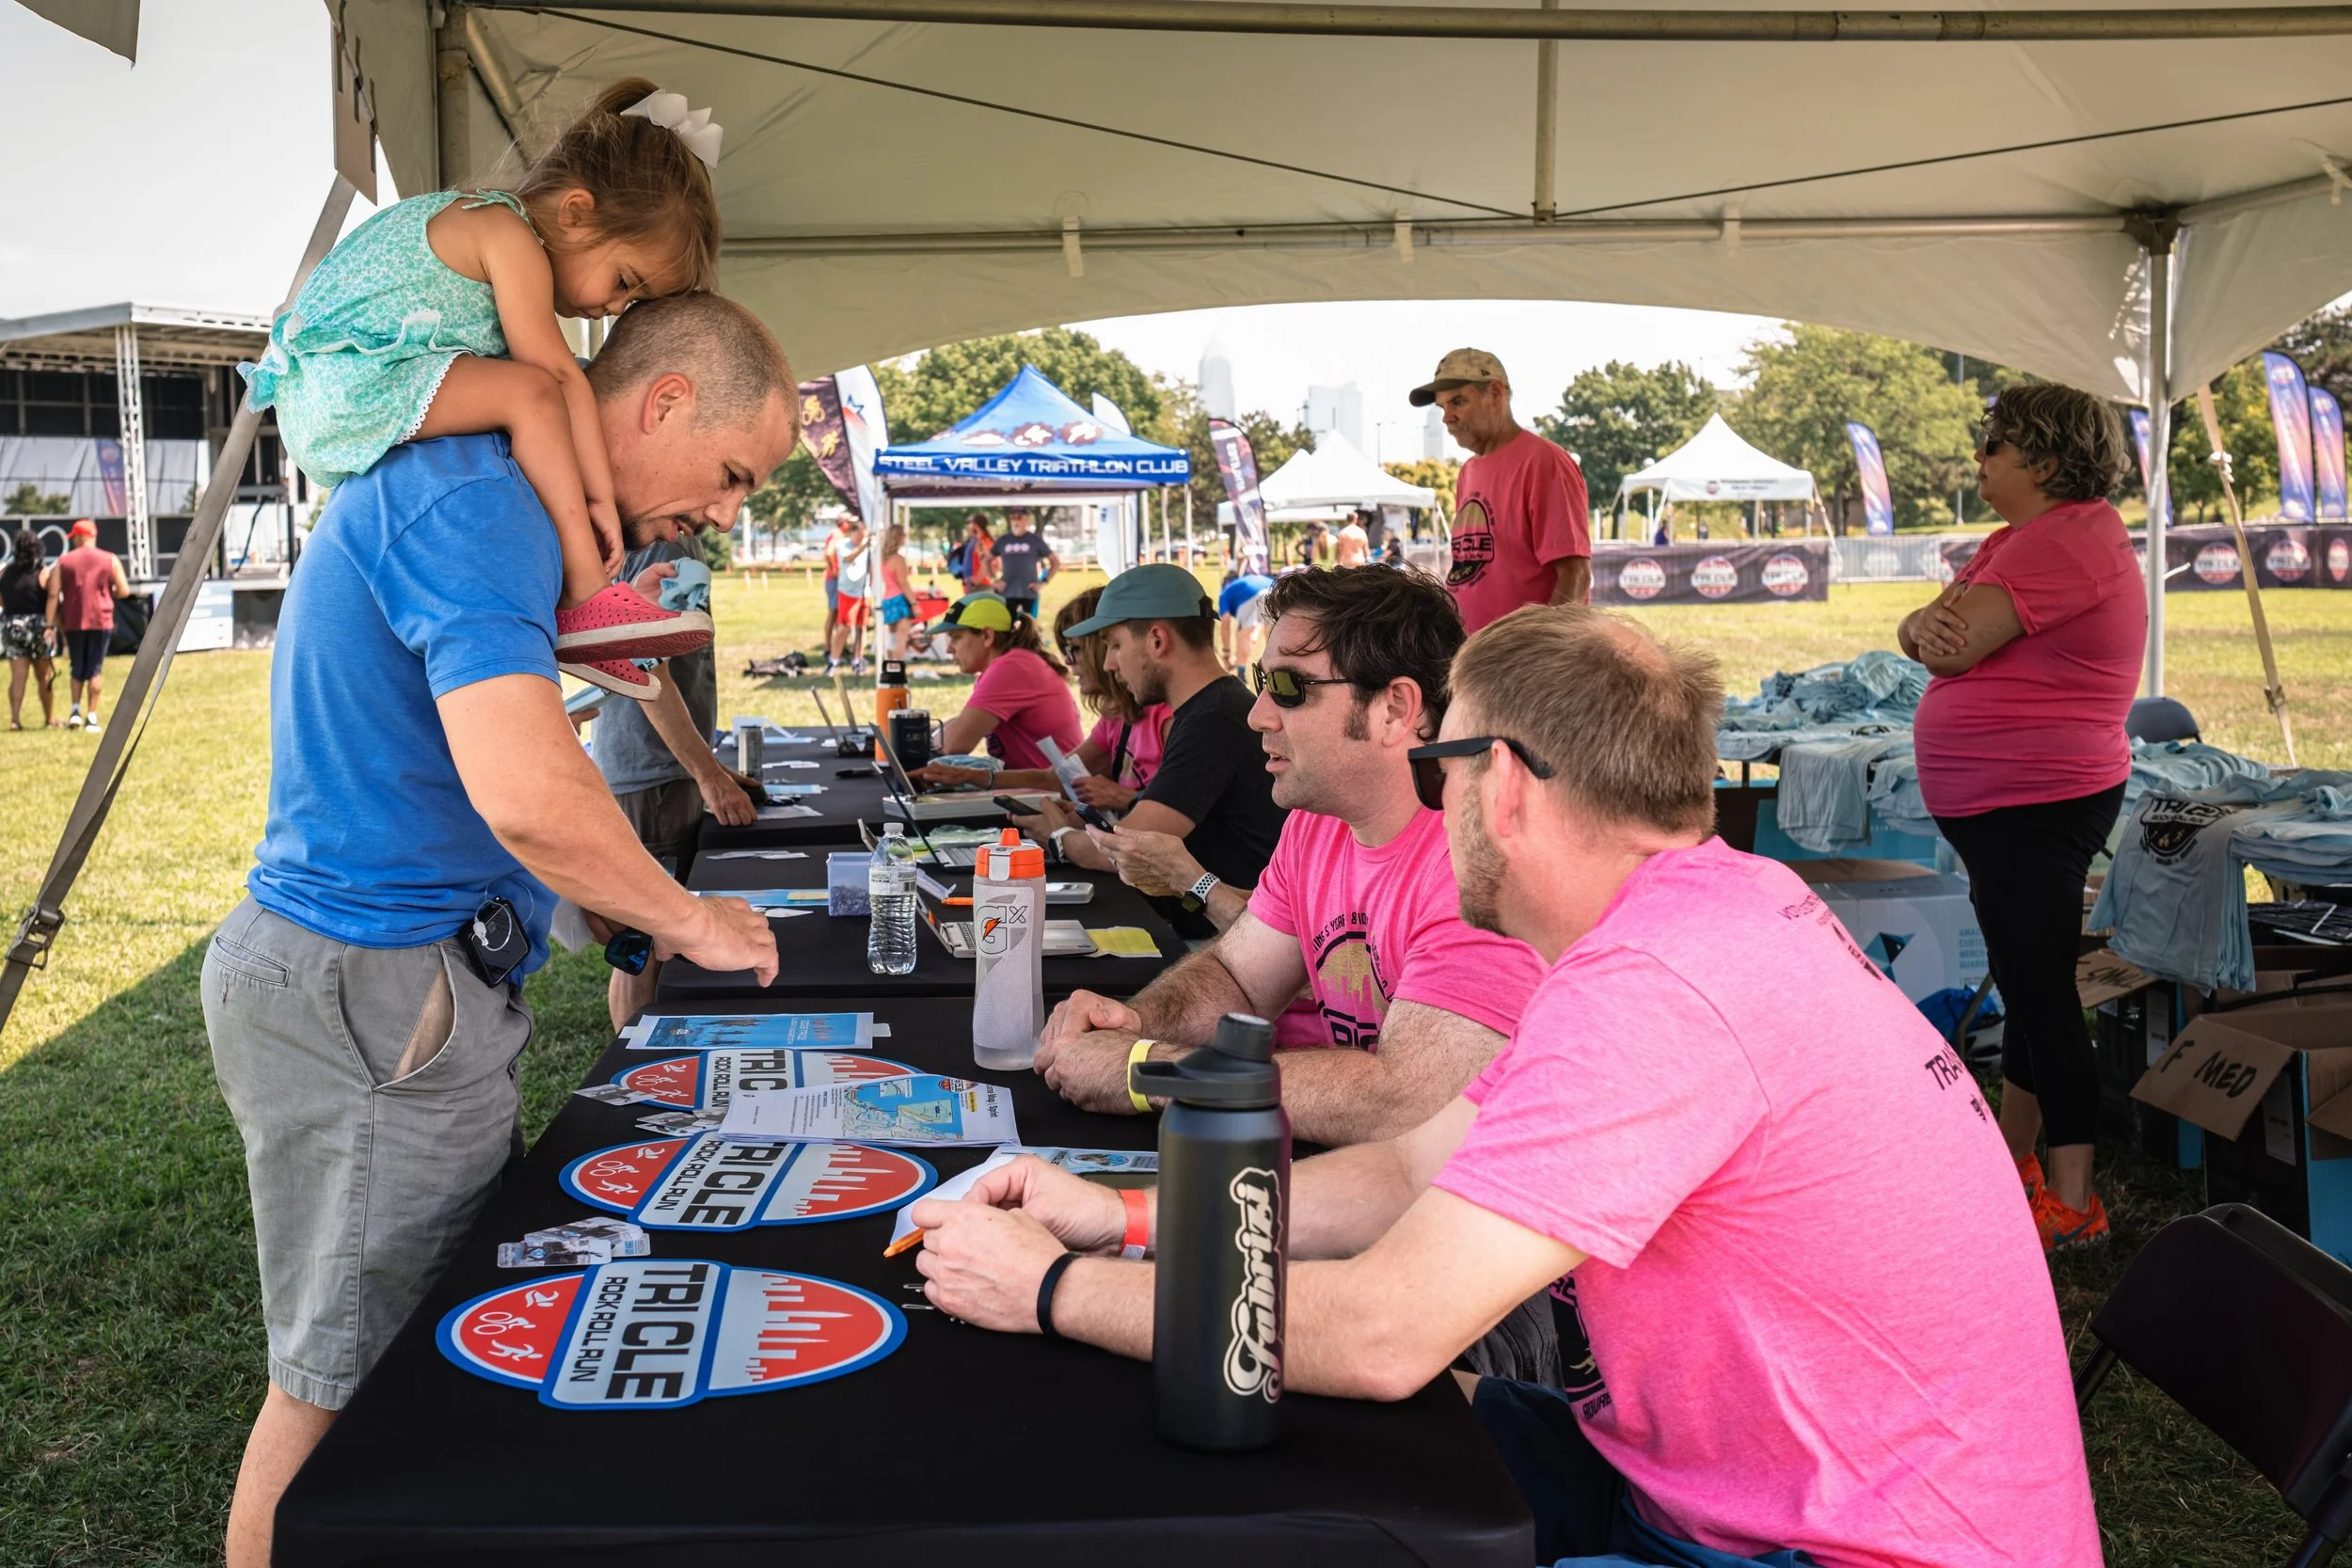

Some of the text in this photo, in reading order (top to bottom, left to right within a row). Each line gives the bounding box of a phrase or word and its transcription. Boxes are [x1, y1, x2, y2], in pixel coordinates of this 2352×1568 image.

[879, 455, 1189, 474] STEEL VALLEY TRIATHLON CLUB
[711, 1056, 732, 1108] ROCK ROLL RUN
[739, 1049, 788, 1091] TRIC
[2160, 1040, 2258, 1099] F MED
[654, 1139, 726, 1211] ROCK ROLL RUN
[677, 1142, 789, 1226] RICLE
[568, 1276, 629, 1383] ROCK ROLL RUN
[604, 1263, 710, 1401] TRICLE
